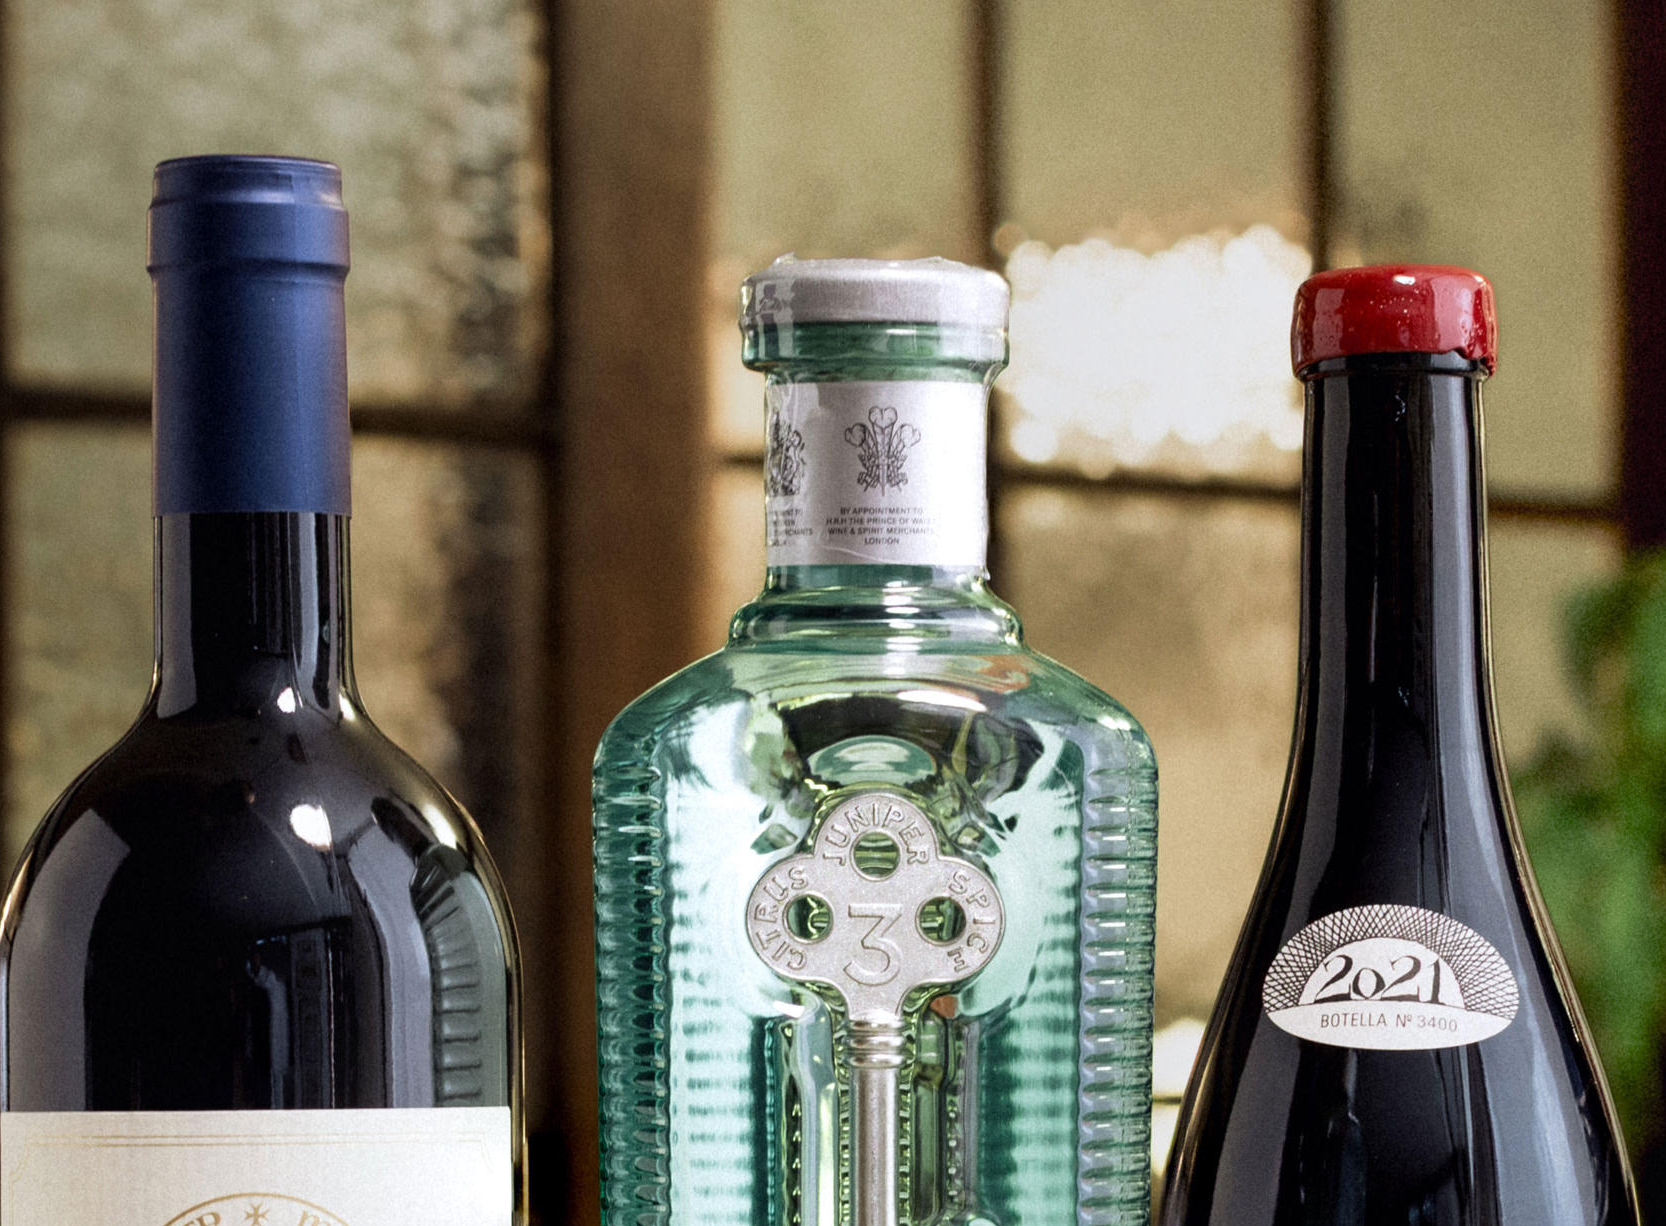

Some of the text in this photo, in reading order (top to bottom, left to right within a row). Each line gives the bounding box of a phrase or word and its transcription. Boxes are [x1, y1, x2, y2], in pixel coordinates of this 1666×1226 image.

[849, 516, 865, 525] THE
[867, 516, 896, 525] PRINCE
[853, 507, 911, 515] APPOINTMENT
[828, 527, 847, 536] WINE
[858, 527, 884, 536] SPIRIT
[864, 537, 900, 546] LONDON
[823, 803, 929, 866] JUNIPER
[754, 866, 809, 971] CITRUS
[947, 870, 996, 973] SPICE
[843, 903, 903, 986] 3
[1314, 954, 1445, 1005] 2021
[1320, 1013, 1387, 1028] BOTELLA
